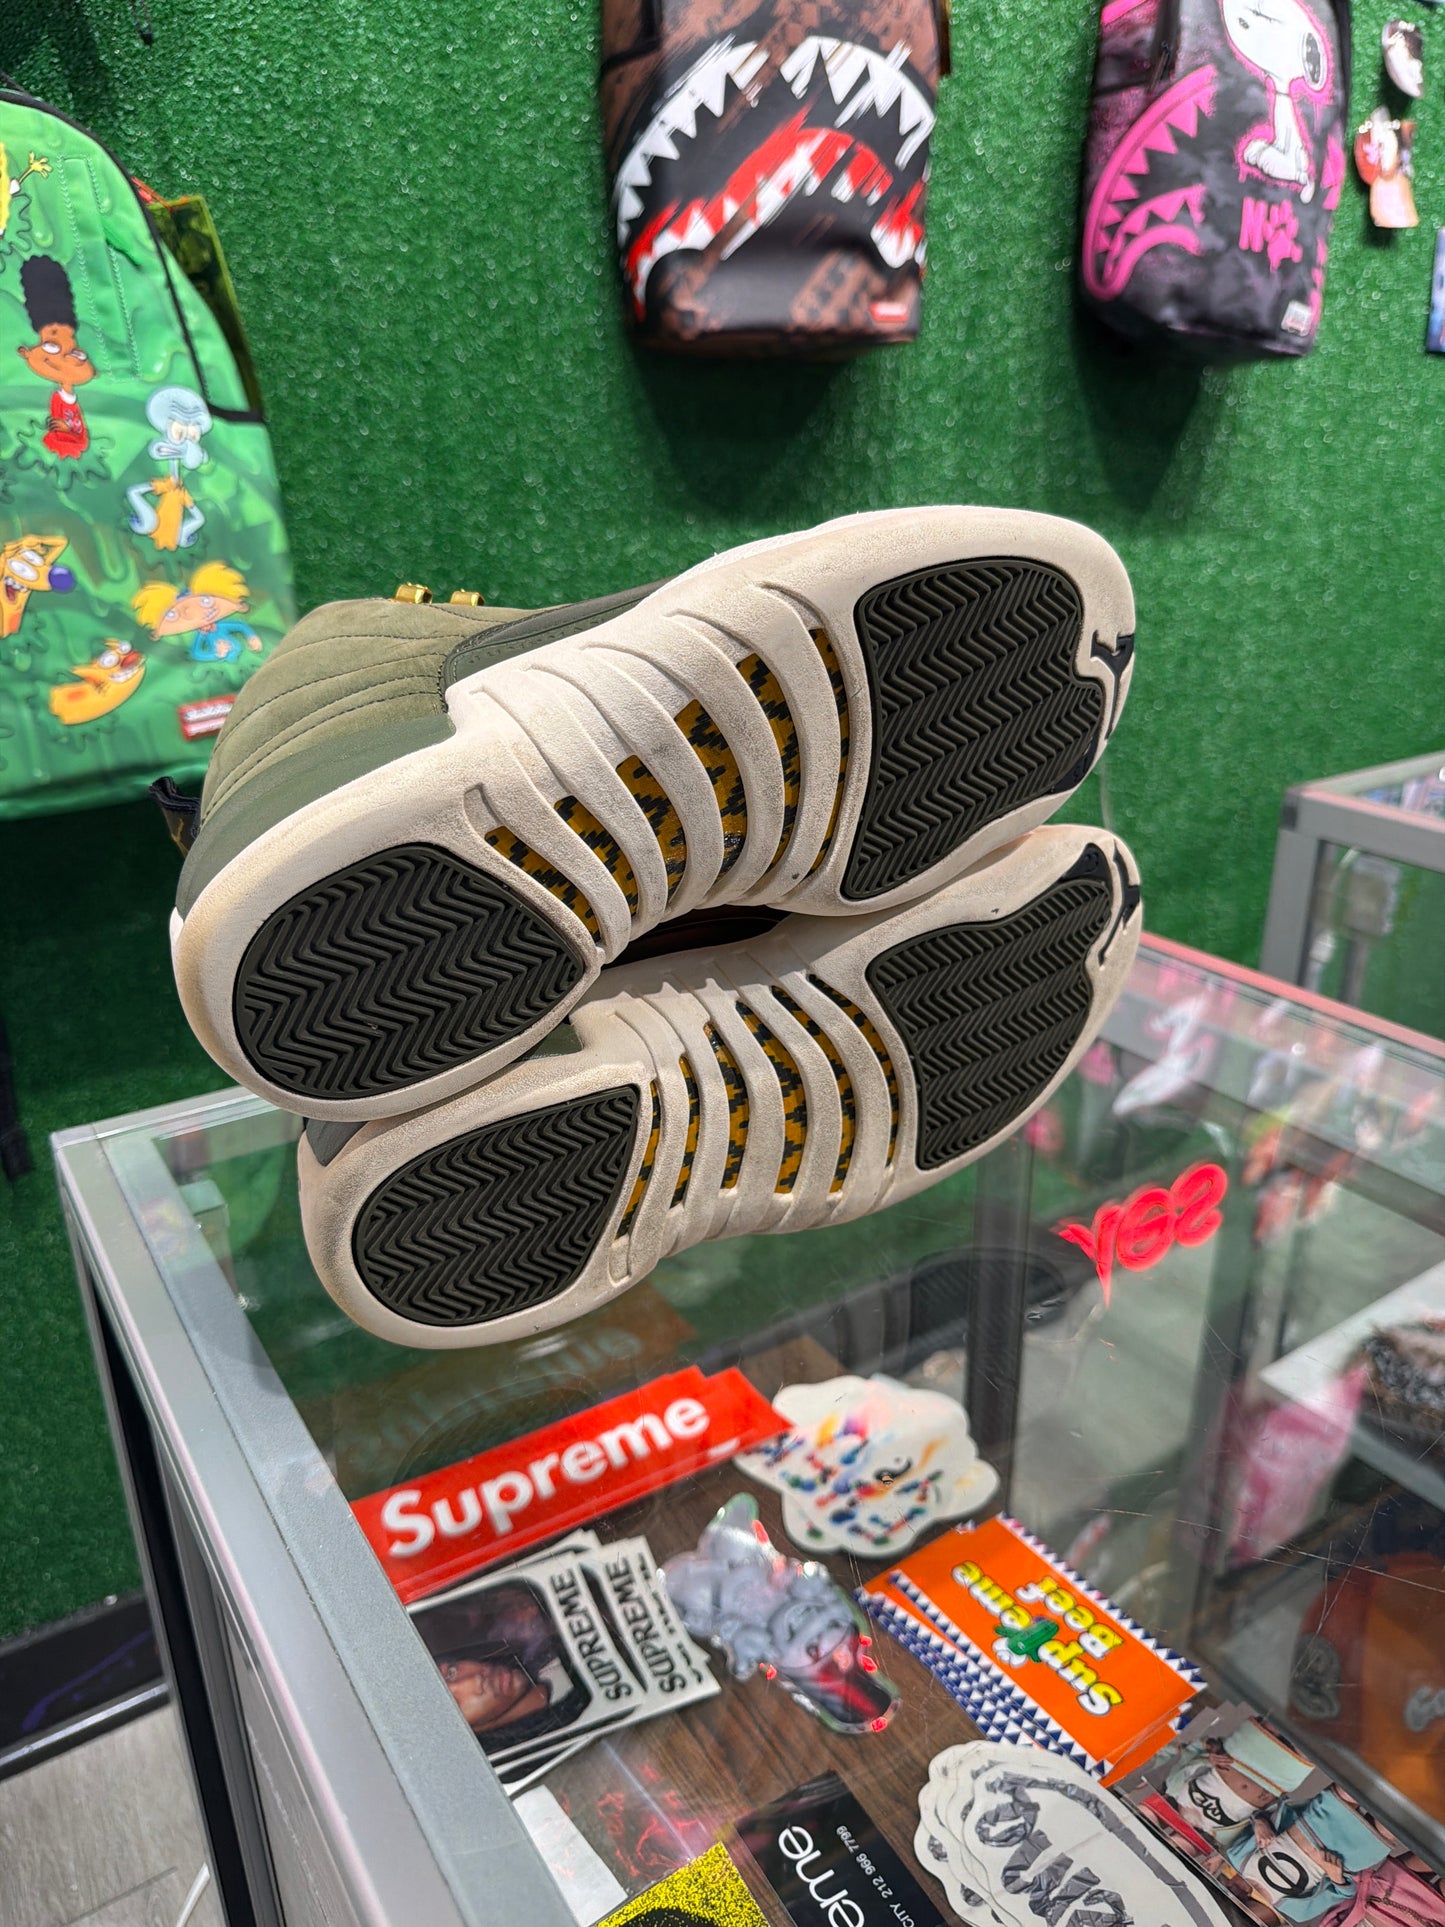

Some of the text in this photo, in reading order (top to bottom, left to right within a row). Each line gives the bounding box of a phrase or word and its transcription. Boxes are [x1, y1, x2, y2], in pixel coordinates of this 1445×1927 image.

[380, 1397, 711, 1558] Supreme
[550, 1568, 633, 1701] SUPREME
[605, 1557, 687, 1693] SUPREME
[951, 1560, 1124, 1717] Supeme
[1014, 1576, 1124, 1660] Beef
[836, 1825, 860, 1853] 7799
[855, 1852, 877, 1876] 966
[872, 1875, 893, 1899] 212
